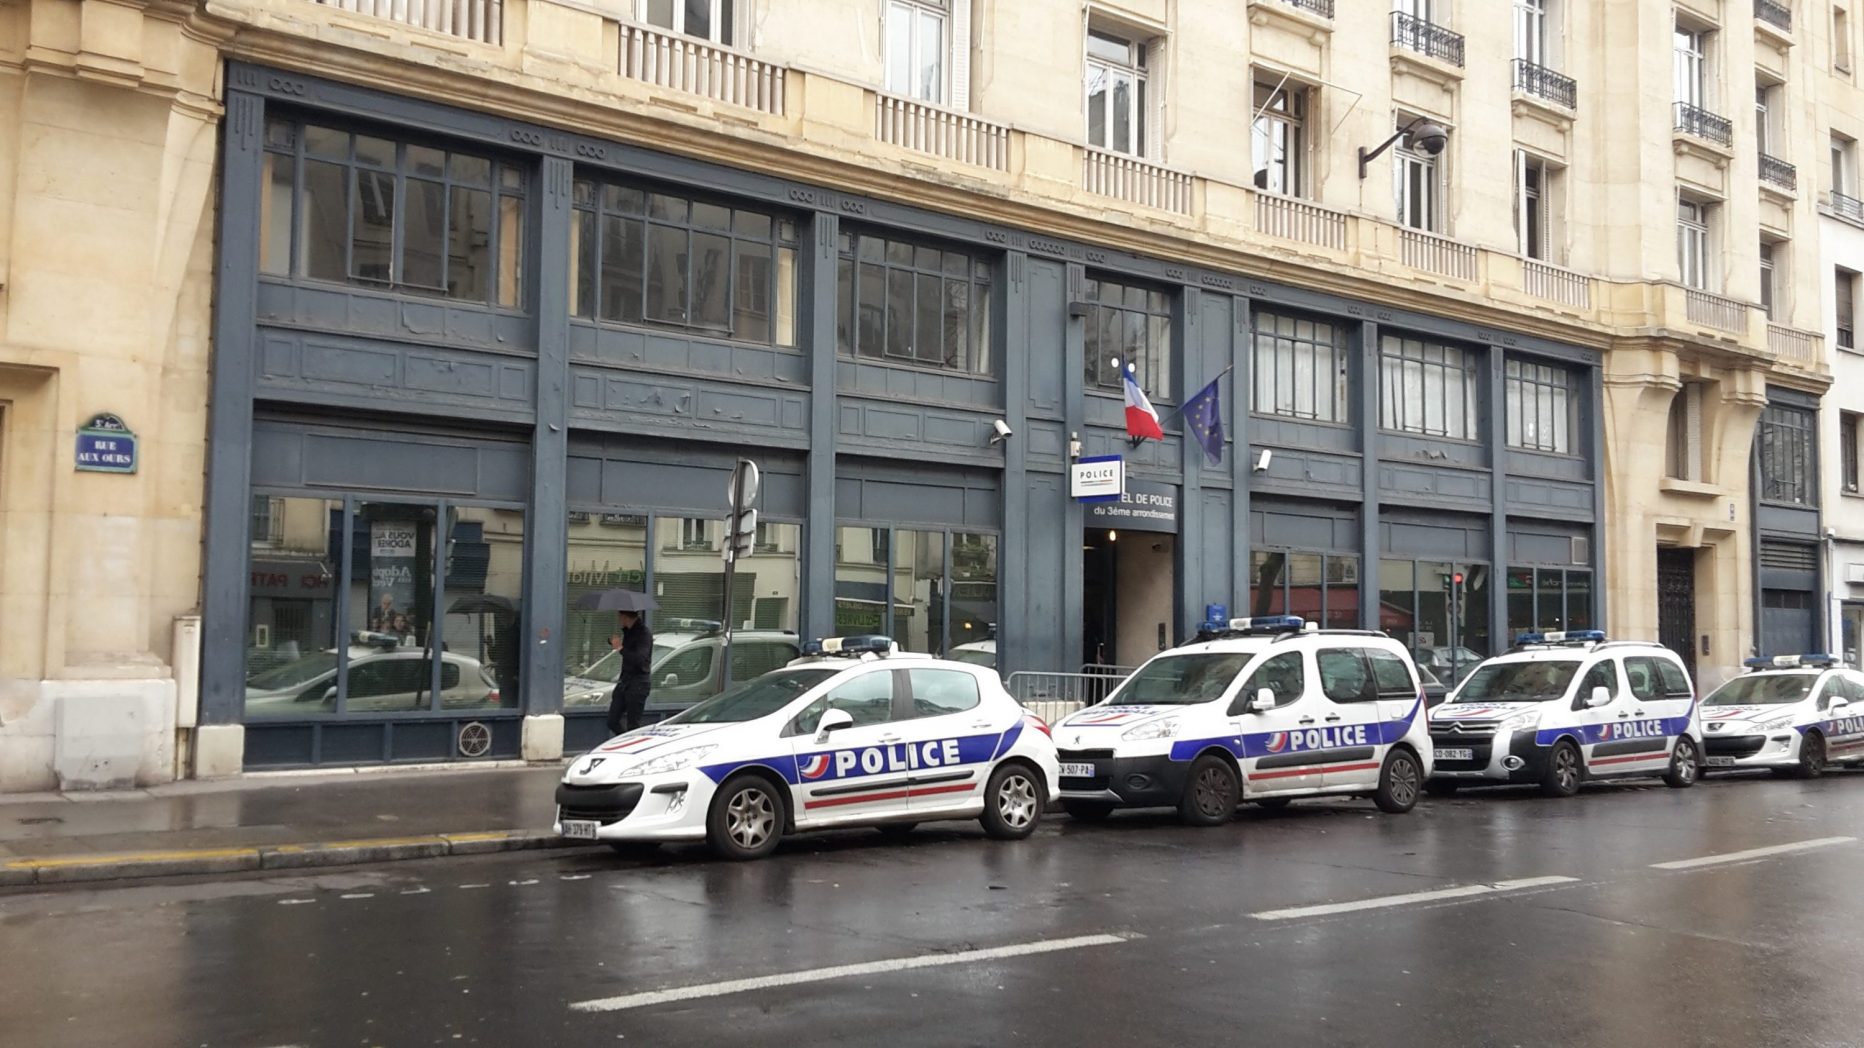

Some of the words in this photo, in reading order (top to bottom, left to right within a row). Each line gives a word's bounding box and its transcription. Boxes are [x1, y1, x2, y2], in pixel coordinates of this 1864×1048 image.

[94, 440, 117, 451] RUE
[79, 452, 99, 462] AUX
[101, 453, 131, 463] OURS
[1079, 469, 1114, 479] POLICE
[1135, 494, 1148, 505] DE
[1149, 495, 1173, 508] POLICE
[1093, 506, 1106, 516] du
[1613, 719, 1663, 739] POLICE
[1290, 725, 1367, 751] POLICE
[835, 739, 961, 777] POLICE
